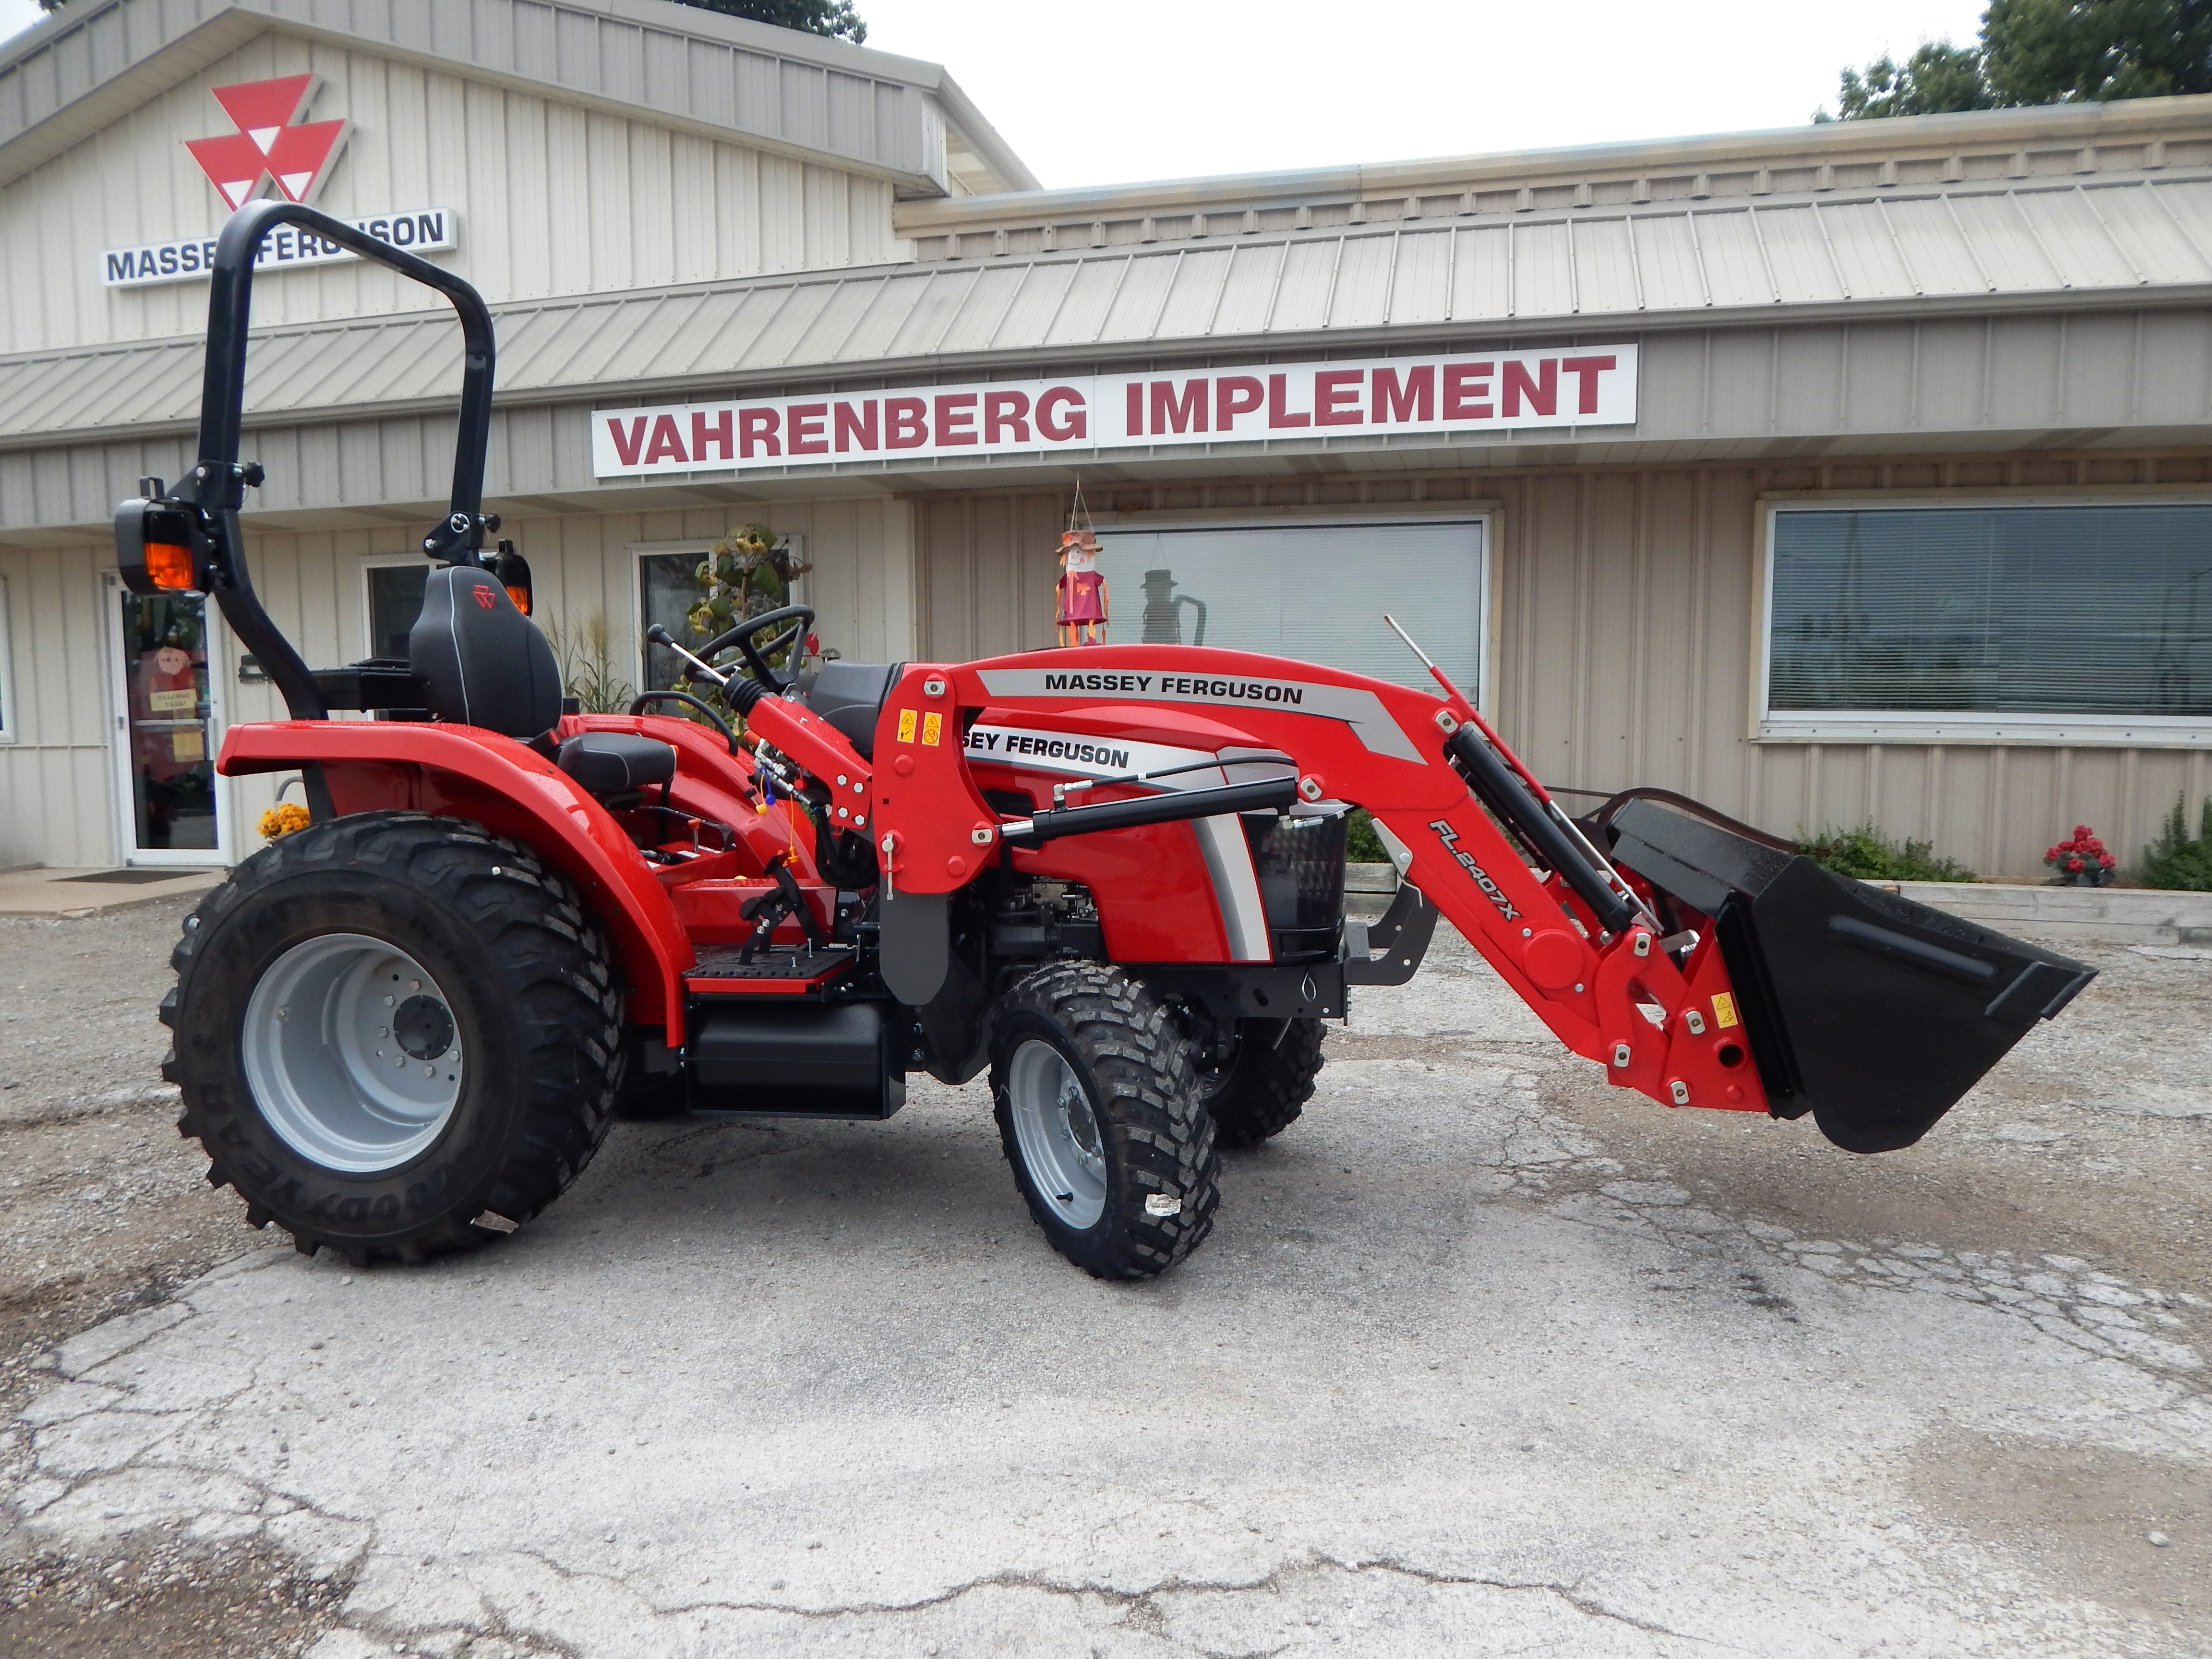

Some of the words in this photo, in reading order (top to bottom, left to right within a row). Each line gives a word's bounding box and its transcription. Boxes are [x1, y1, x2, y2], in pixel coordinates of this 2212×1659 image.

[108, 241, 217, 281] MASSE
[607, 386, 1087, 466] VAHRENBERG
[1126, 355, 1616, 436] IMPLEMENT
[1046, 674, 1152, 691] MASSEY
[1161, 678, 1303, 704] FERGUSON
[1006, 735, 1129, 769] FERGUSON
[1428, 818, 1523, 922] FL.2407X
